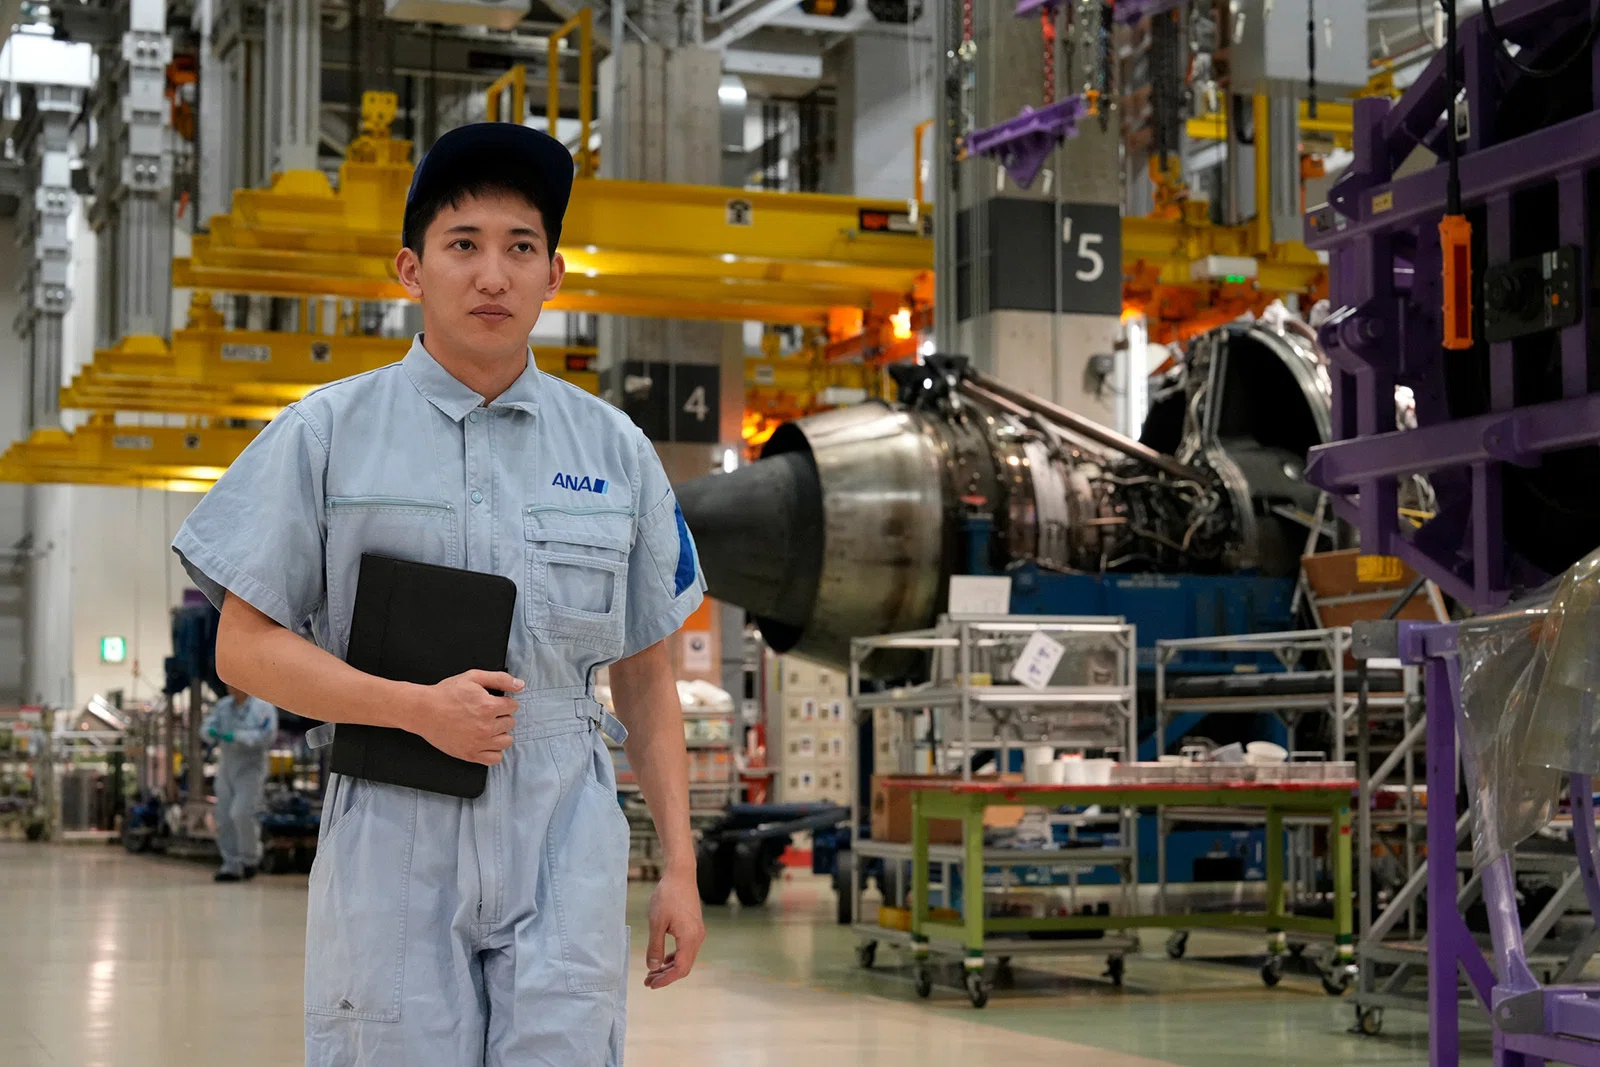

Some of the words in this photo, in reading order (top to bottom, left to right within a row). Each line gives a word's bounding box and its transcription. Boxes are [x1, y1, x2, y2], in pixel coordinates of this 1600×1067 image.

[1075, 233, 1104, 282] 5
[683, 386, 709, 421] 4
[552, 472, 592, 492] ANA
